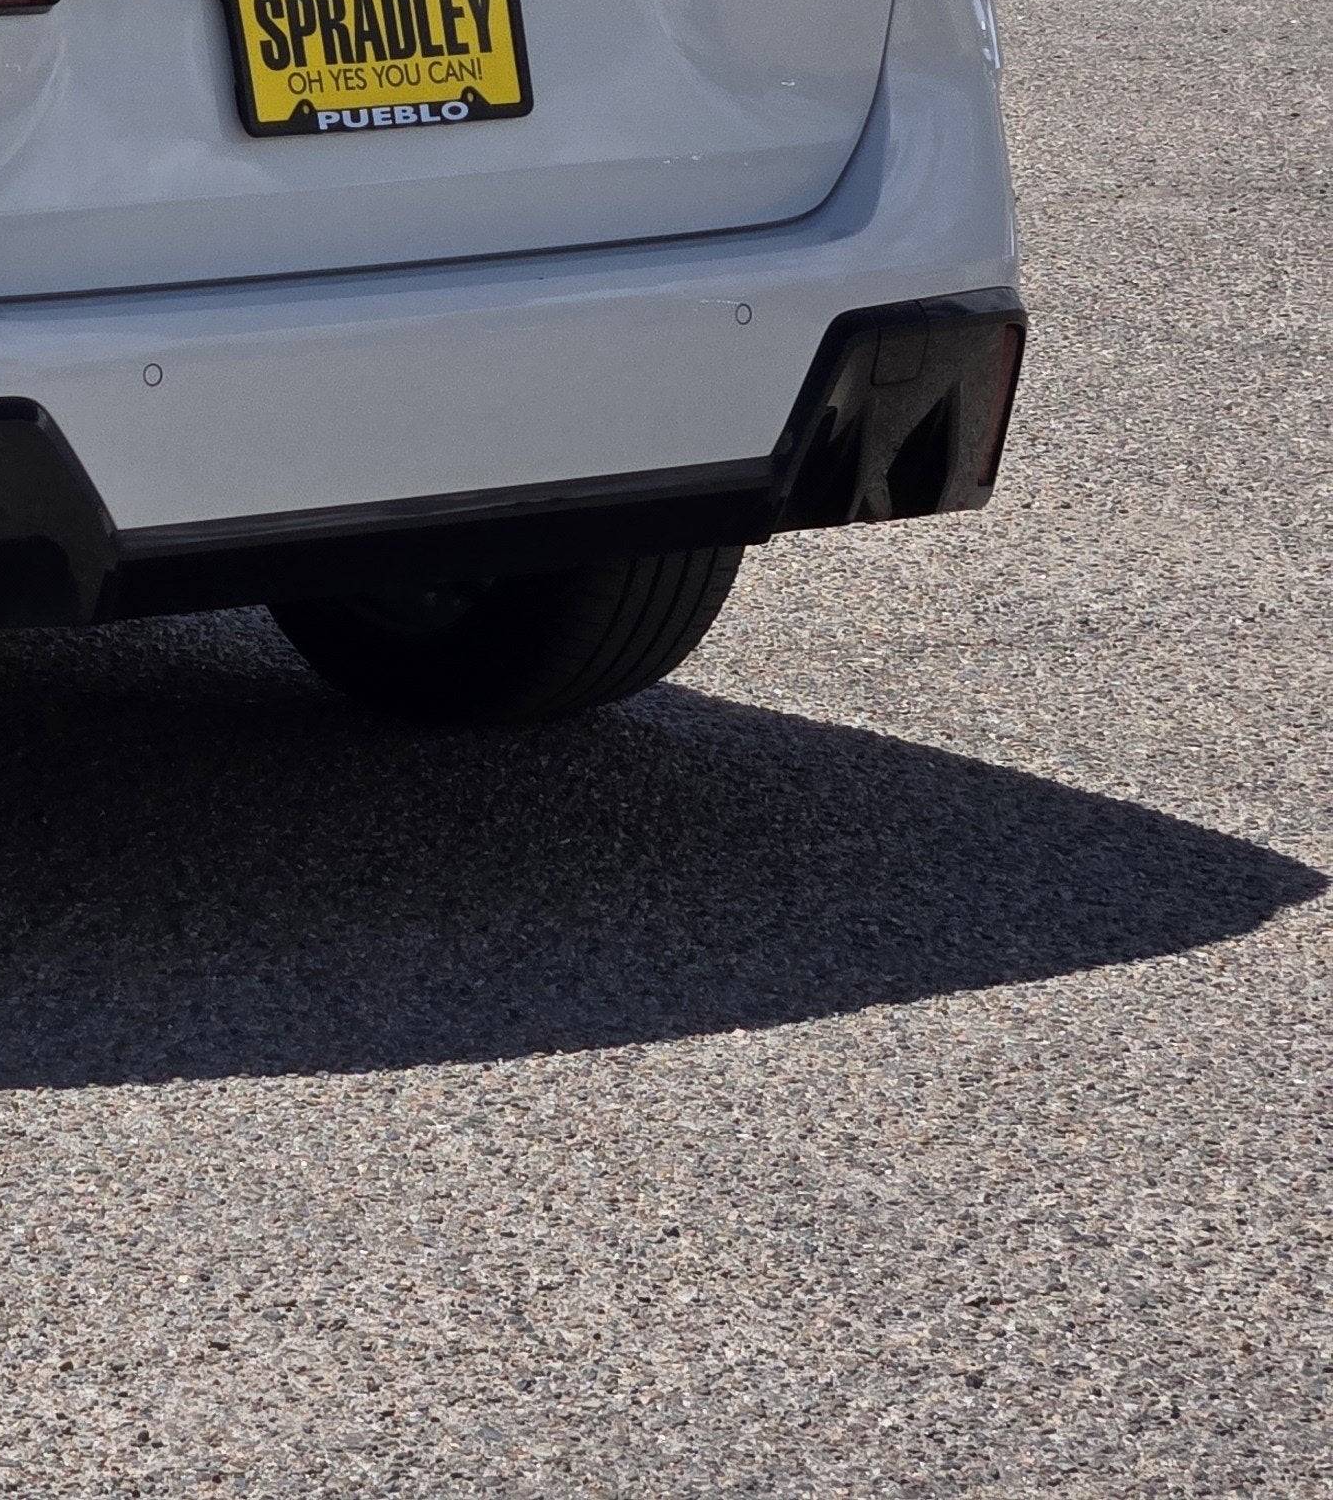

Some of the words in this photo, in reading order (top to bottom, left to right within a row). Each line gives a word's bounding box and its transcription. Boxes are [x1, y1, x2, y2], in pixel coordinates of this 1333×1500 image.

[287, 70, 324, 95] OH
[331, 67, 367, 91] YES
[371, 62, 421, 88] YOU
[428, 58, 483, 84] CAN!
[318, 101, 469, 130] PUEBLO
